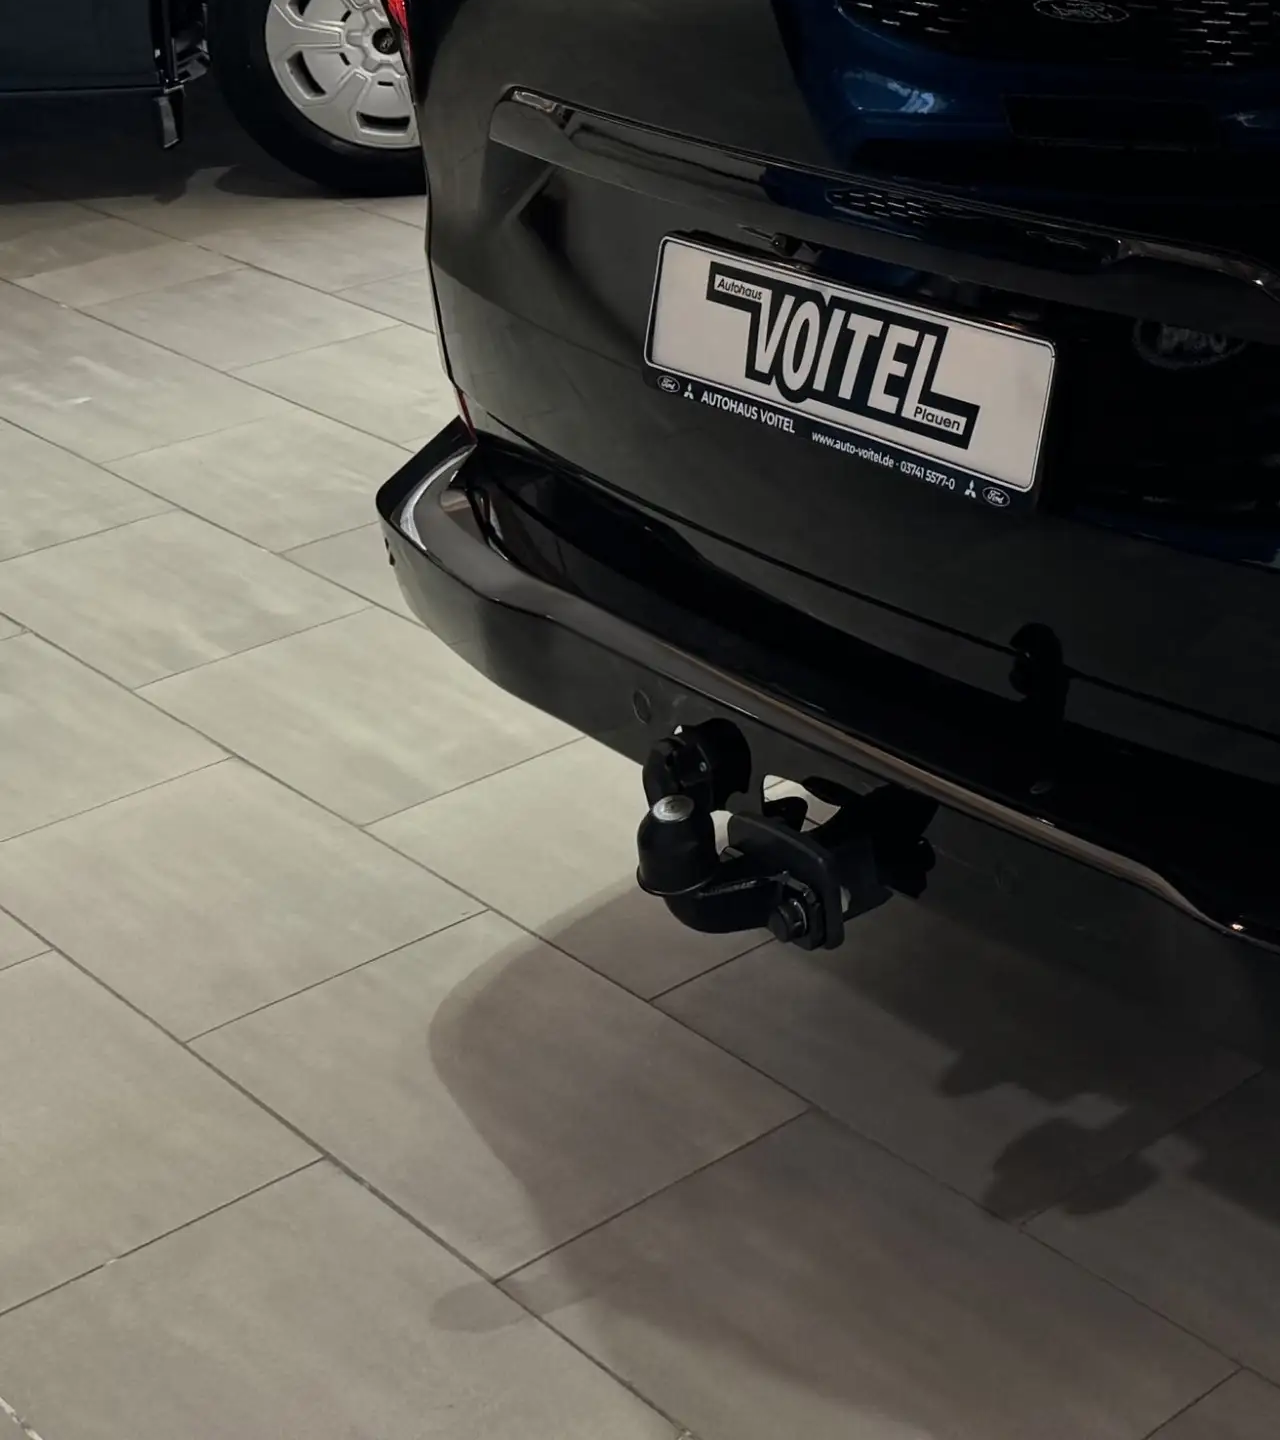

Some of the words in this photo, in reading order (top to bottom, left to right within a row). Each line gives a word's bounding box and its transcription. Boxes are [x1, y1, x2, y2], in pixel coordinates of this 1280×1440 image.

[716, 278, 763, 301] Autohaus
[754, 294, 938, 417] VOITEL
[700, 390, 758, 420] AUTOHAUS
[760, 409, 796, 434] VOITEL
[913, 405, 961, 432] Plauen
[811, 431, 894, 468] www.auto-voitel.de
[900, 460, 925, 480] 03741
[925, 470, 956, 491] 5577-0
